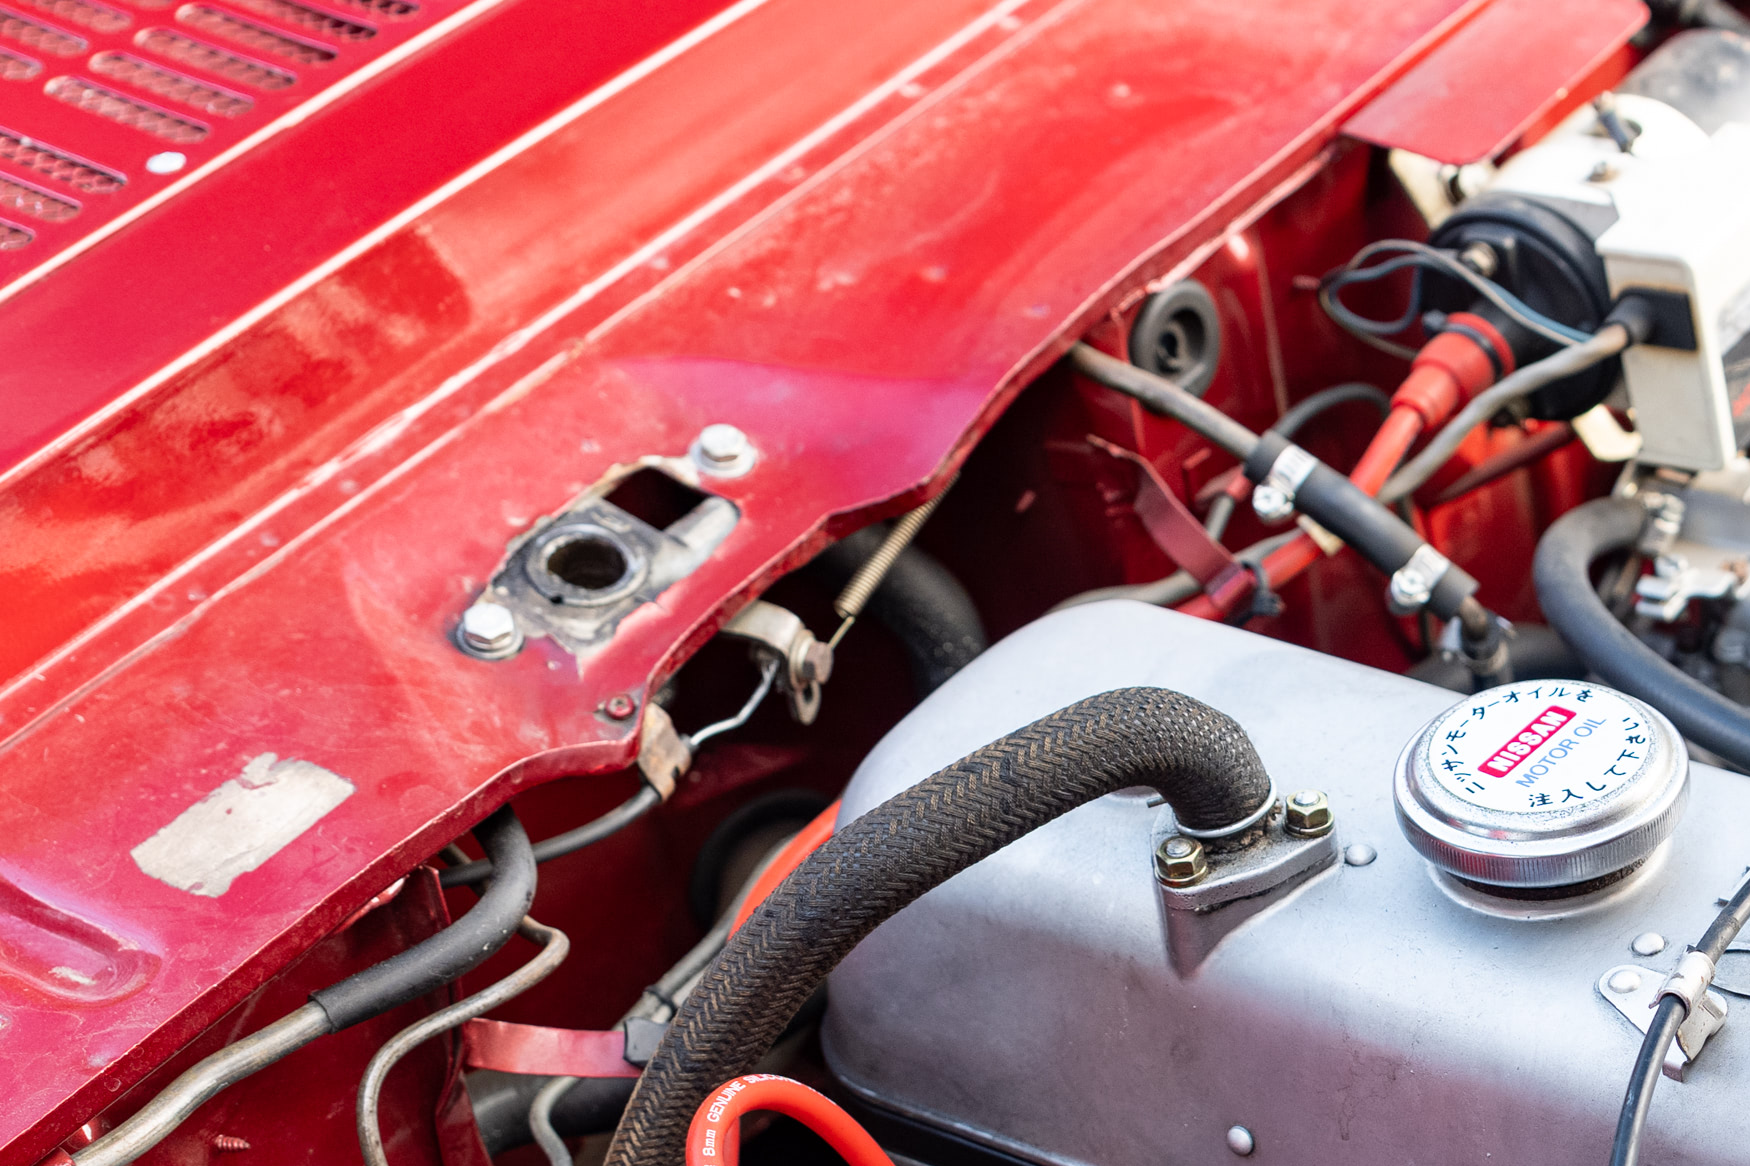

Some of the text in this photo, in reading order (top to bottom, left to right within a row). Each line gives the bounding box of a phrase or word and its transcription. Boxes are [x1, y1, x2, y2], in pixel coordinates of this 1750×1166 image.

[1486, 710, 1568, 772] NISSAN
[1515, 717, 1607, 788] MOTOR OIL
[706, 1080, 746, 1123] GENUINE
[702, 1129, 717, 1157] 8mm
